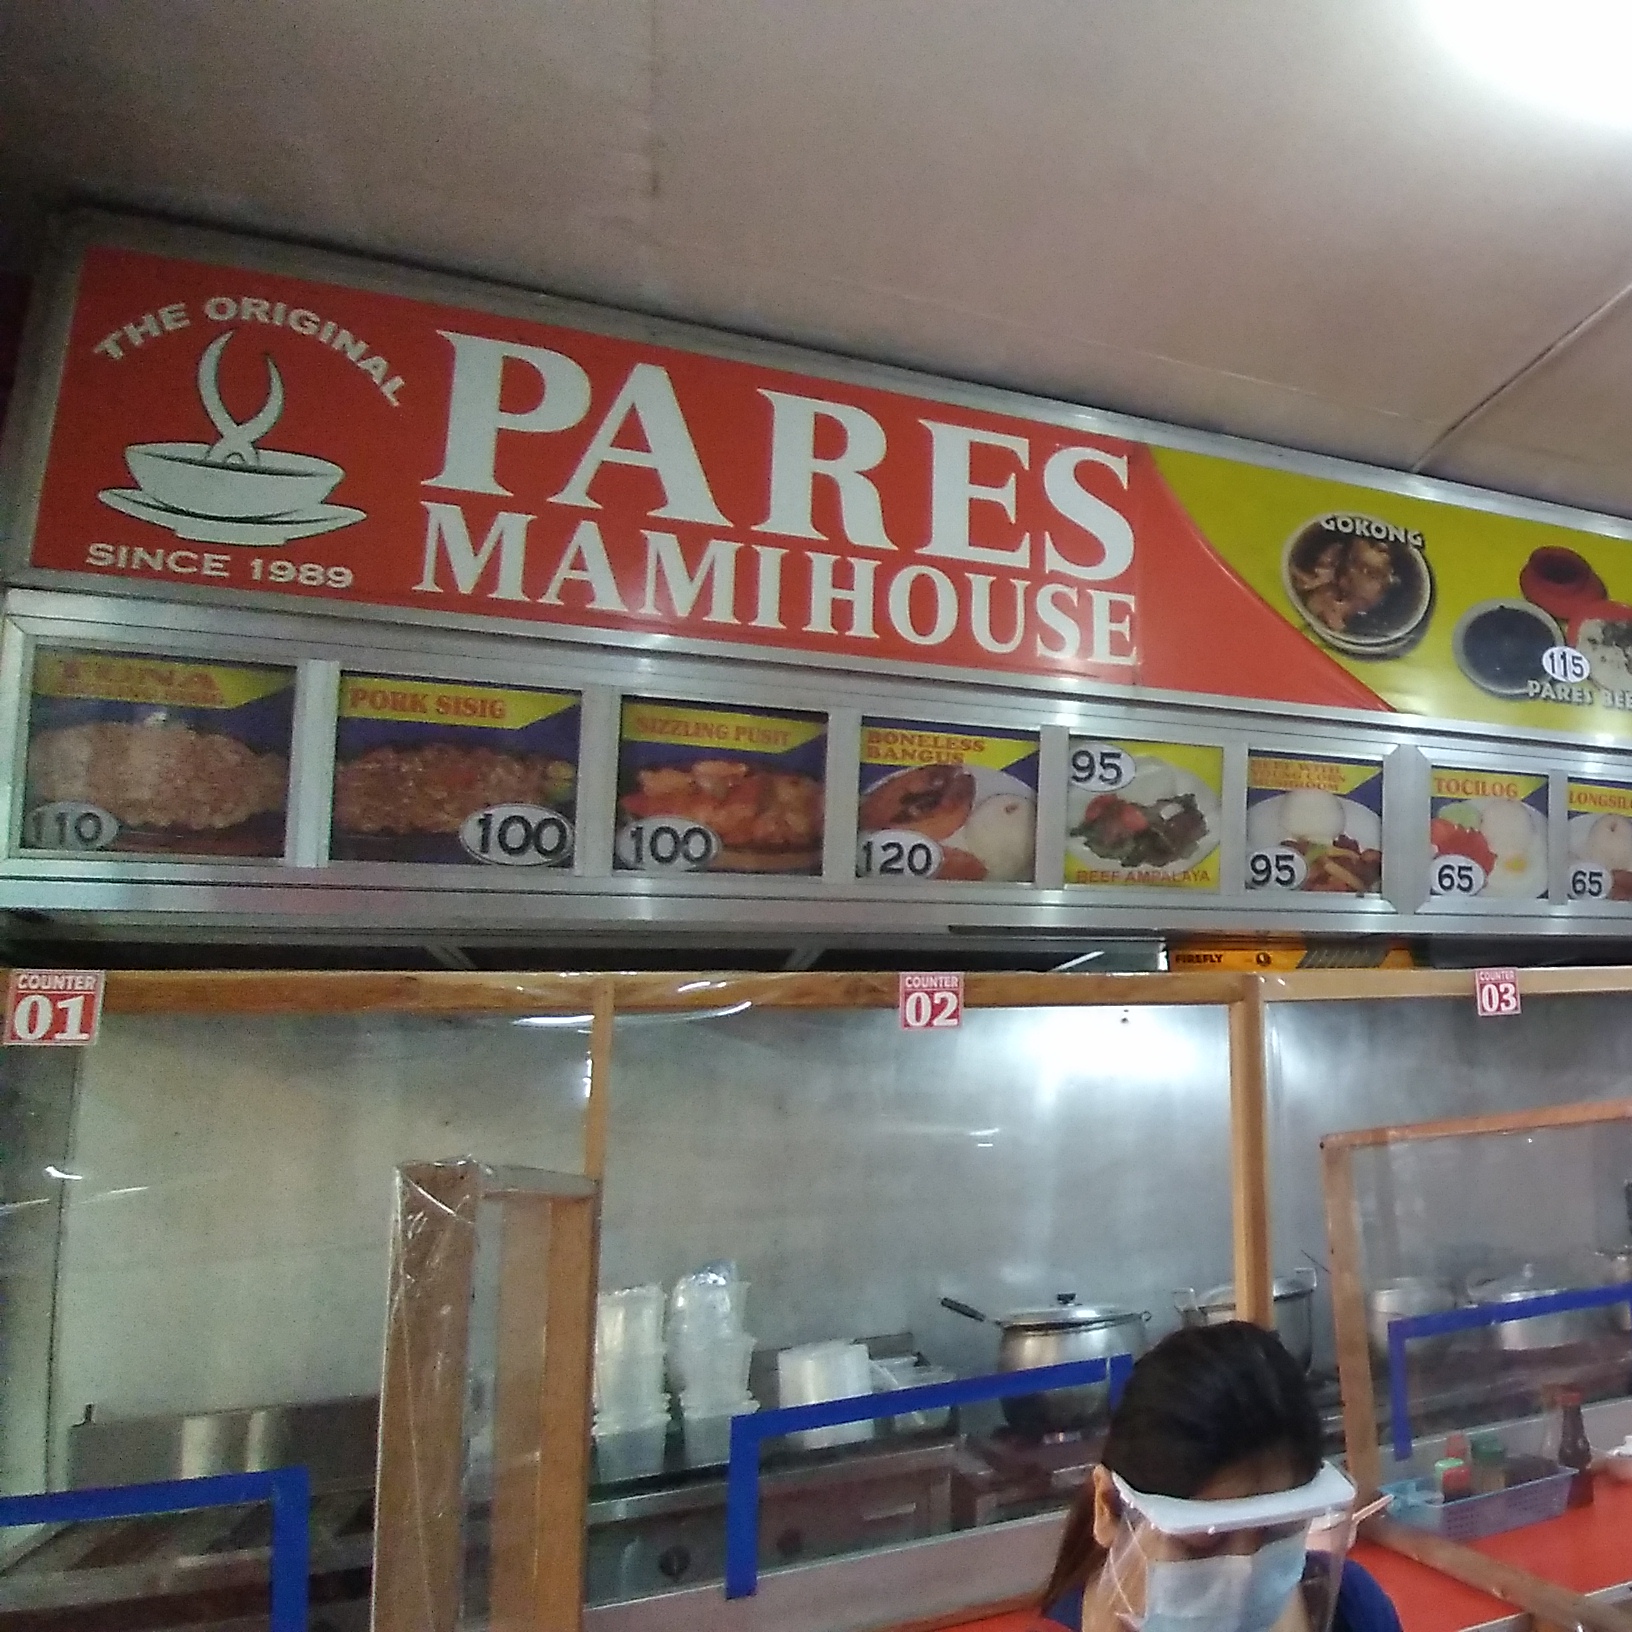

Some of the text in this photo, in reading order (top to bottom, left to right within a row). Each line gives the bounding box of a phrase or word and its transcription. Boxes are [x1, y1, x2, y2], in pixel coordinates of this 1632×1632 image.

[93, 296, 407, 408] THE ORIGINAL
[420, 328, 1136, 582] PARES
[1320, 514, 1425, 547] GOKONG
[86, 541, 354, 590] SINCE 1989
[1547, 651, 1585, 679] 115
[348, 687, 507, 720] PORK SISIG
[1526, 678, 1593, 705] PARES
[636, 715, 730, 741] SIZZLING
[867, 730, 986, 752] BONELESS
[866, 744, 965, 765] BANGUS
[1071, 749, 1123, 786] 95
[1434, 776, 1518, 798] TOCILOG
[26, 811, 102, 846] 110
[478, 811, 568, 858] 100
[630, 825, 713, 865] 100
[860, 841, 932, 877] 120
[1076, 869, 1211, 884] BEEF AMPALAYA
[1250, 853, 1296, 887] 95
[1437, 863, 1474, 893] 65
[1571, 870, 1603, 897] 65
[1175, 954, 1224, 964] FIREFLY
[17, 974, 97, 990] COUNTER
[905, 975, 959, 988] COUNTER
[1479, 970, 1515, 981] COUNTER
[905, 991, 959, 1027] 02
[1481, 983, 1517, 1012] 03
[14, 994, 91, 1041] 01
